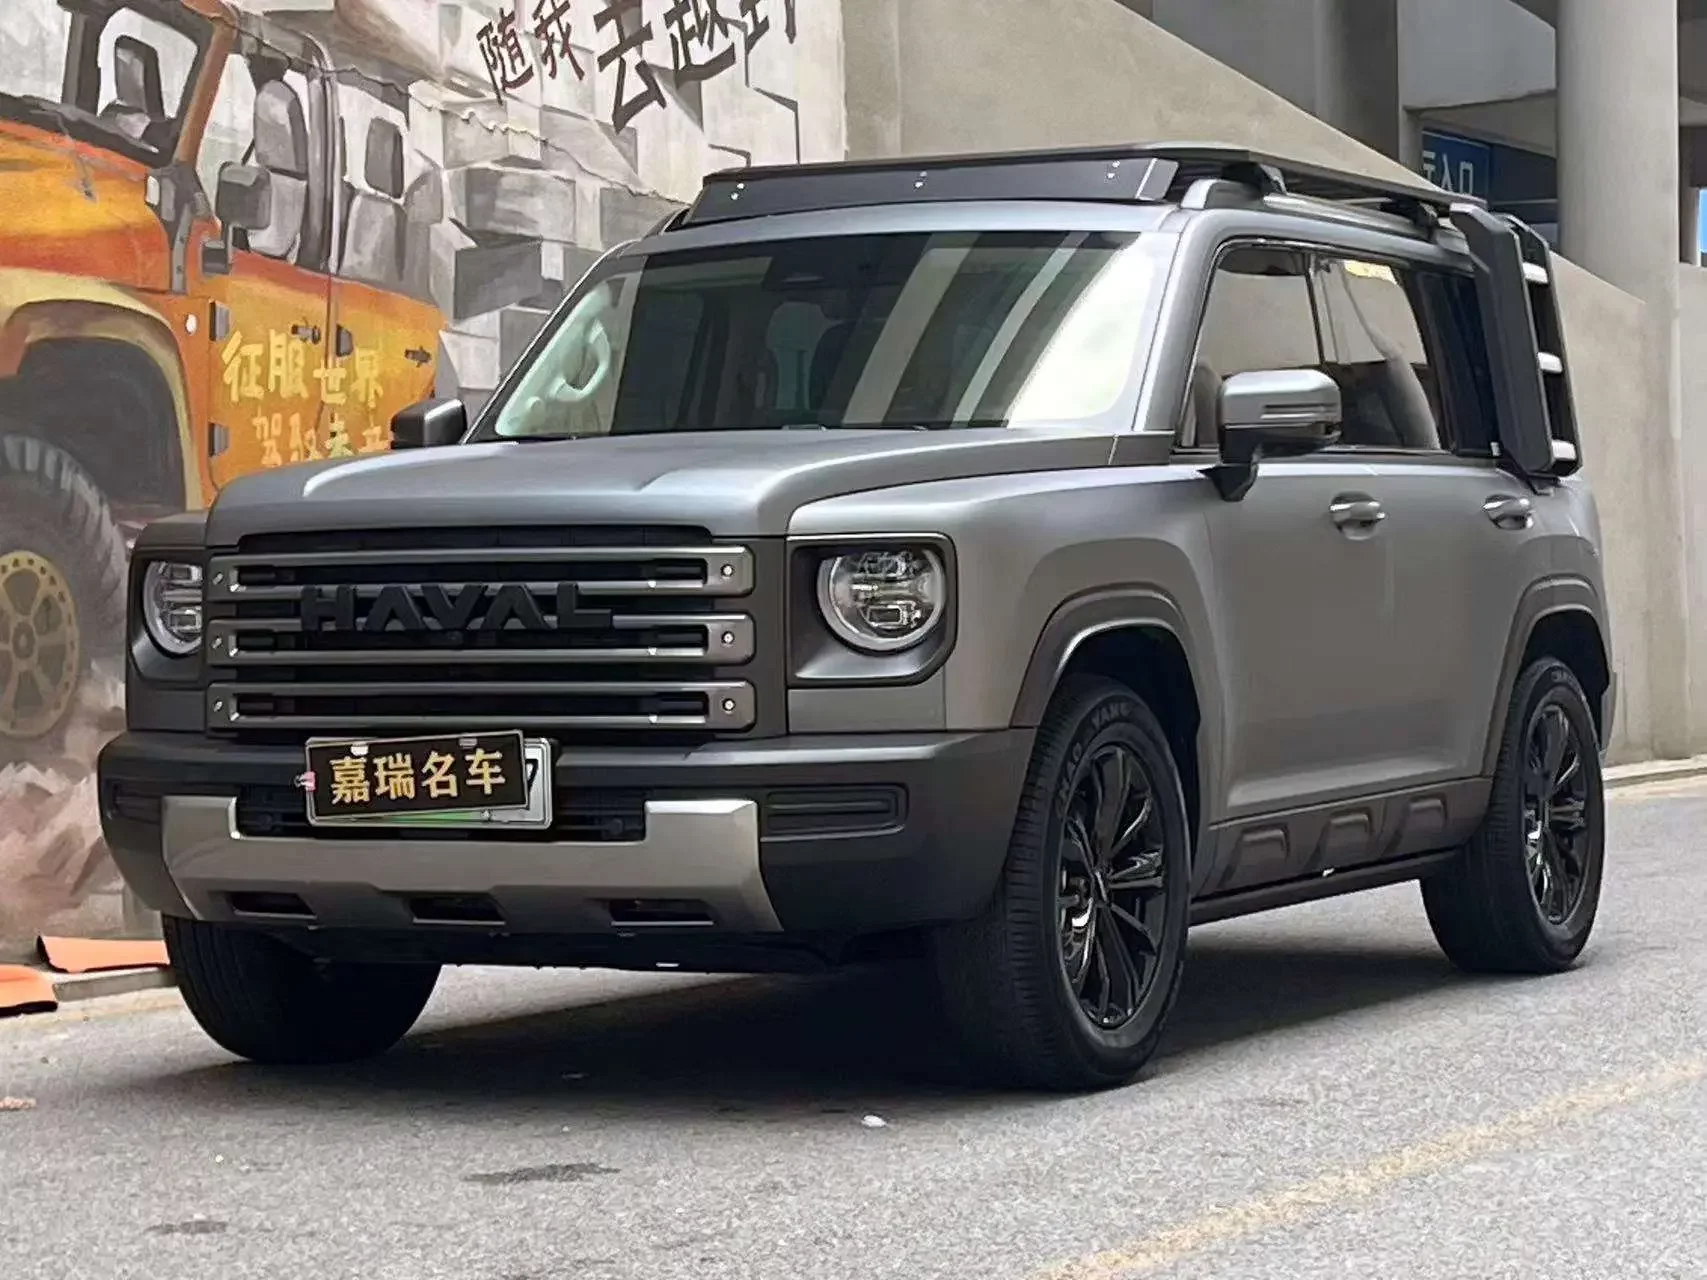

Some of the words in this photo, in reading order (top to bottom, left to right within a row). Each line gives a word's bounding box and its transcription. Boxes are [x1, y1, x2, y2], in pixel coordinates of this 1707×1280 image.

[222, 330, 384, 408] 征服世界
[300, 582, 612, 631] HAVAL
[329, 748, 506, 804] 嘉瑞名车
